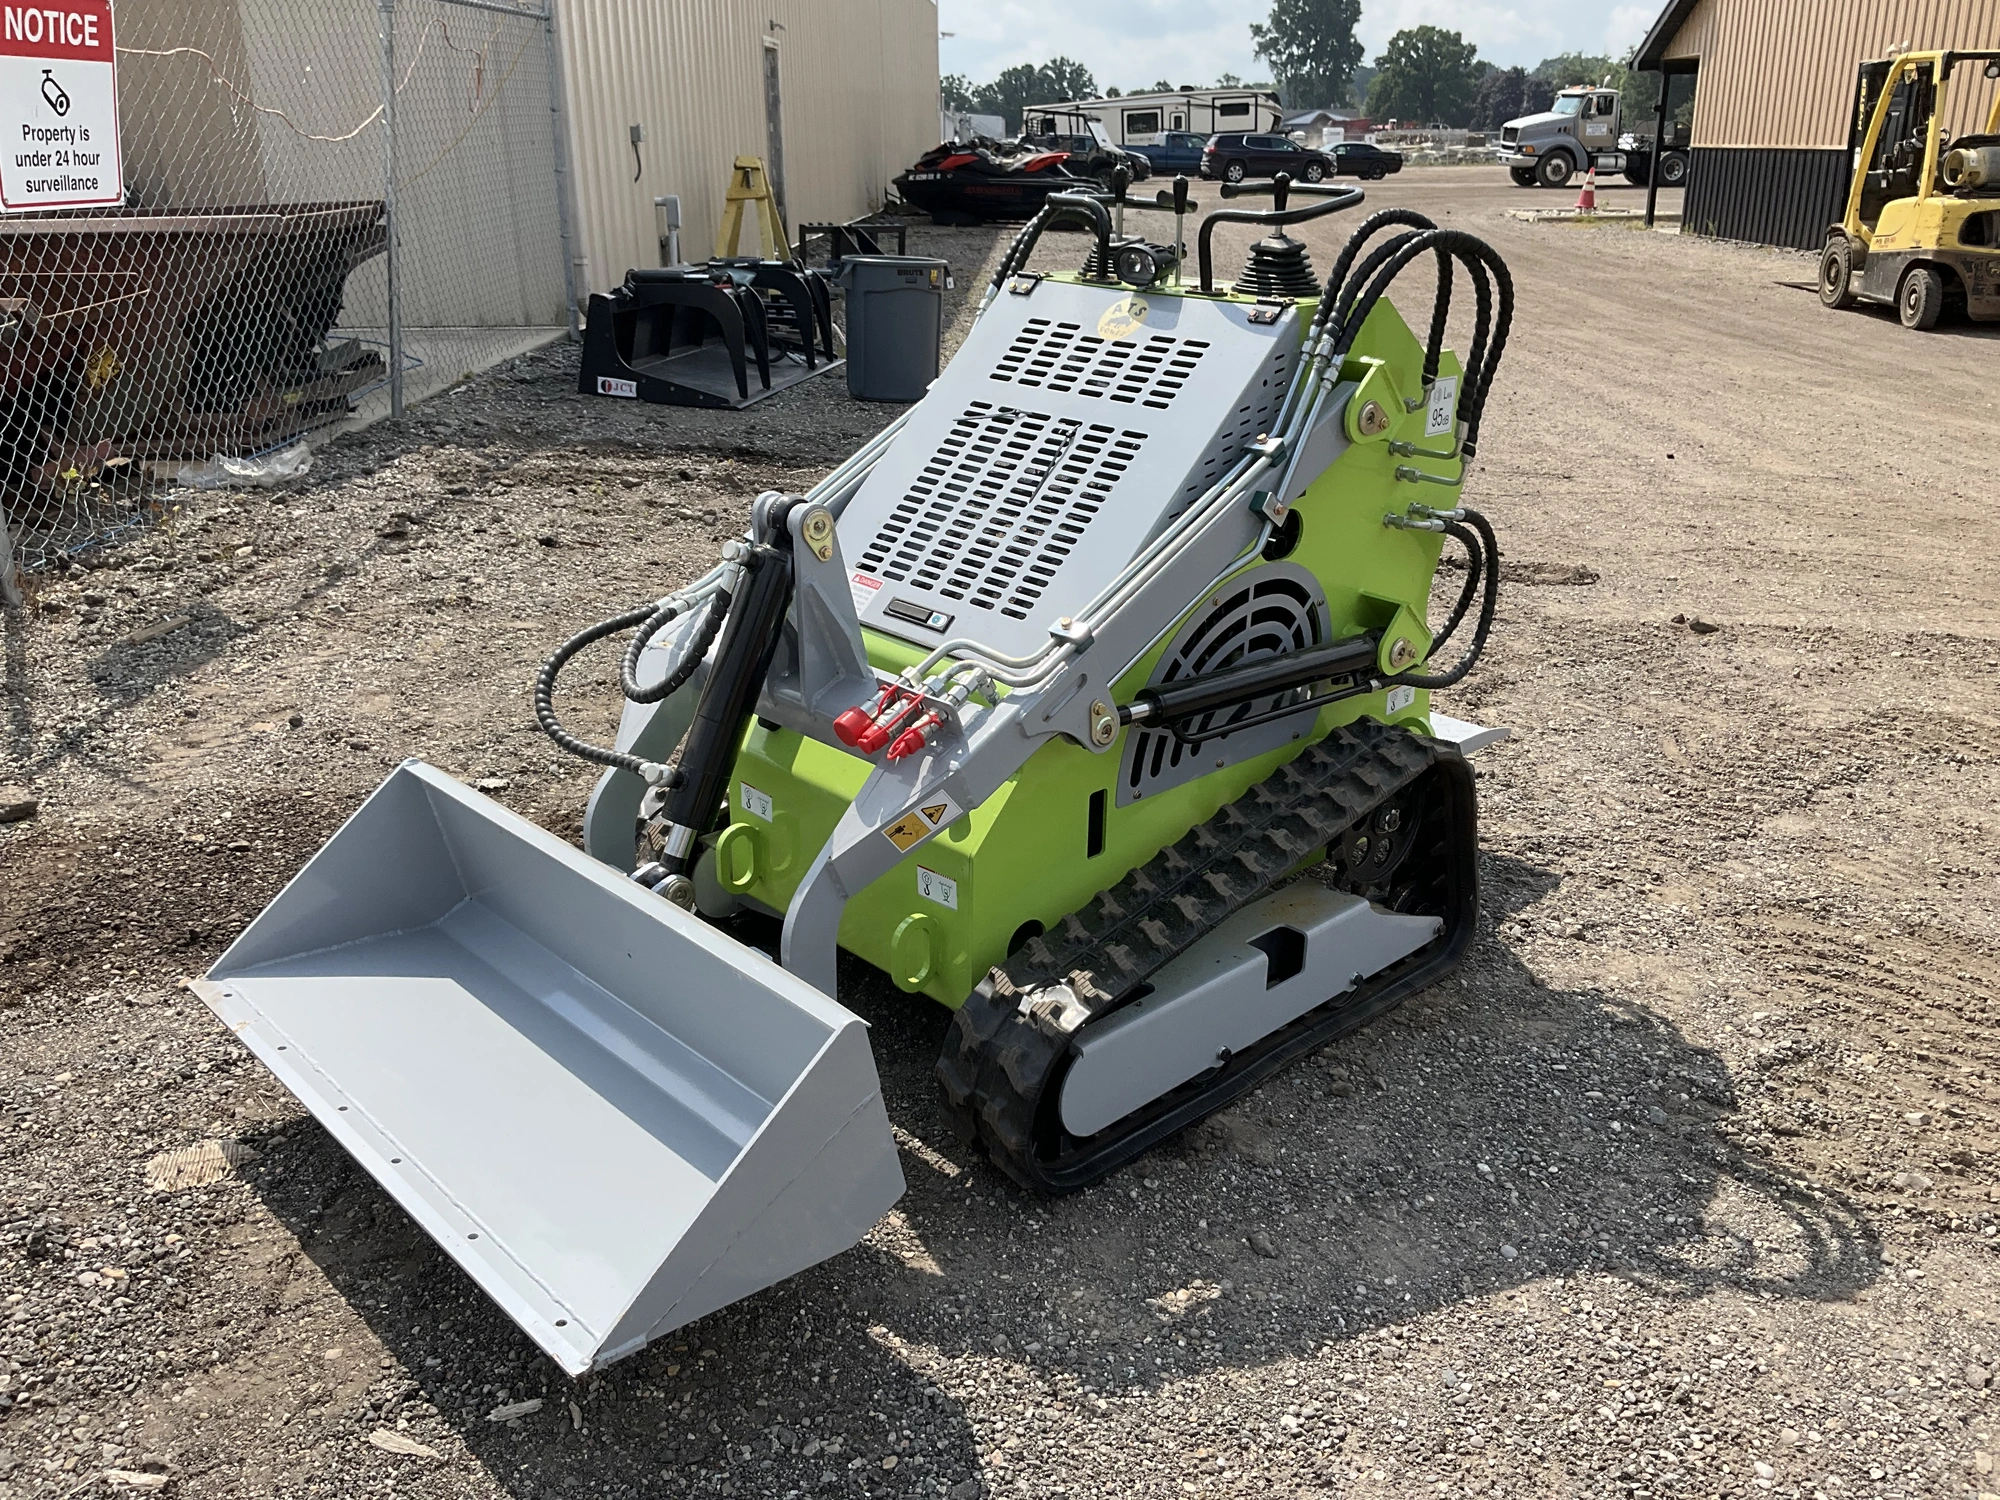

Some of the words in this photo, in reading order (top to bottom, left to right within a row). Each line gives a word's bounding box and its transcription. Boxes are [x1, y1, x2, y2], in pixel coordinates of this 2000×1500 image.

[5, 6, 99, 47] NOTICE
[22, 124, 76, 145] Property
[79, 125, 90, 141] is
[15, 151, 52, 167] under
[55, 151, 70, 166] 24
[73, 150, 100, 166] hour
[26, 175, 99, 193] surveillance
[613, 382, 634, 395] JCT
[860, 577, 880, 589] DANGER
